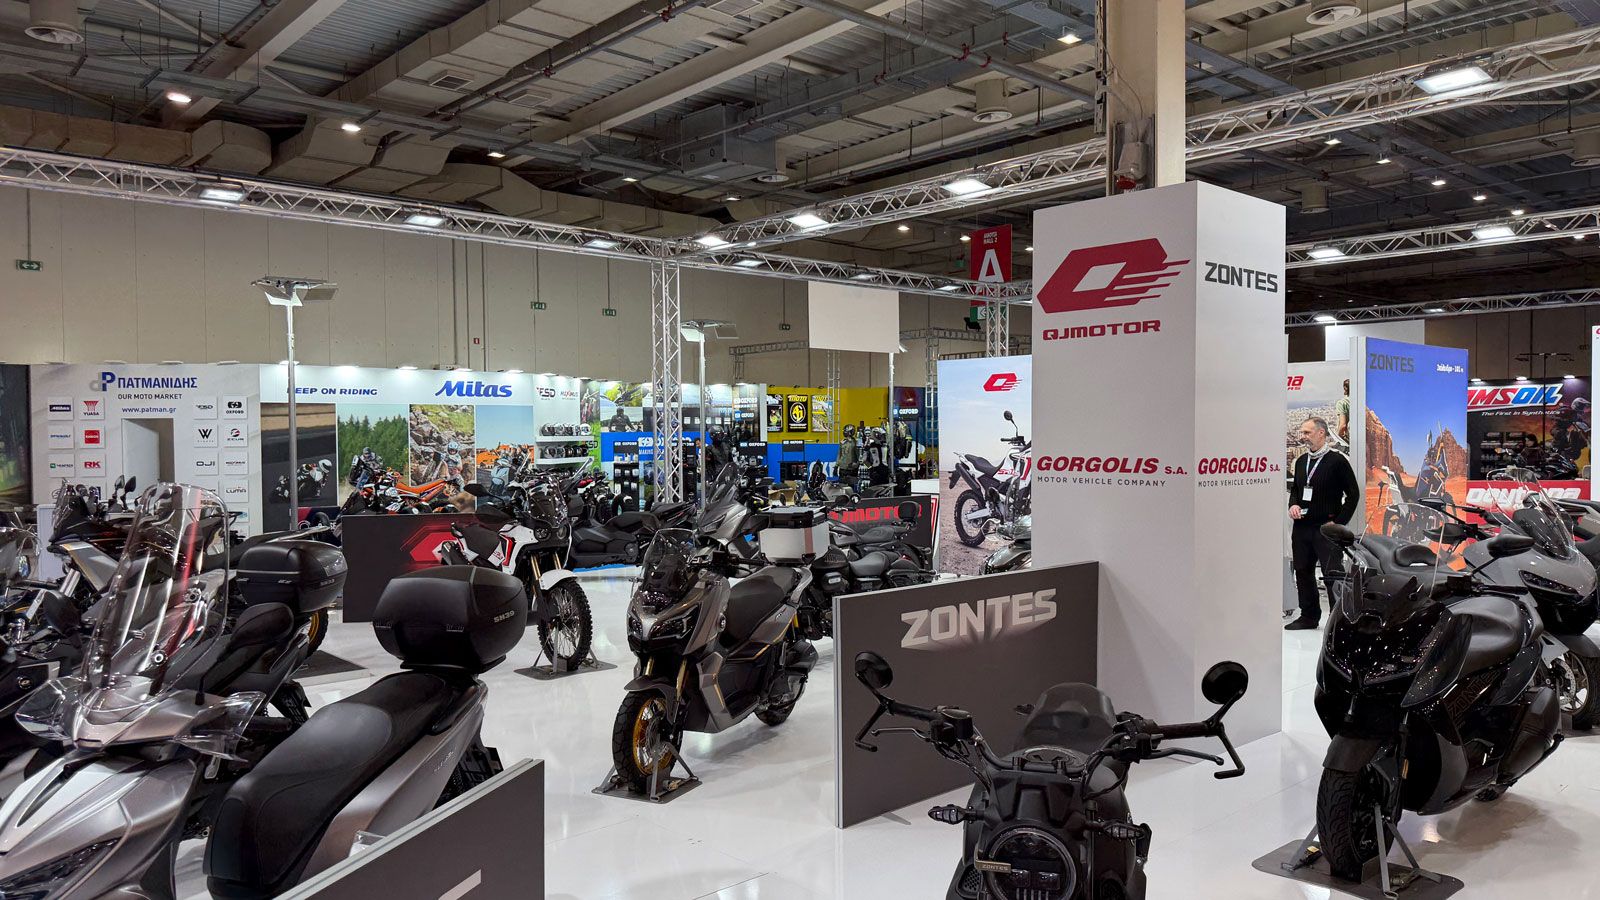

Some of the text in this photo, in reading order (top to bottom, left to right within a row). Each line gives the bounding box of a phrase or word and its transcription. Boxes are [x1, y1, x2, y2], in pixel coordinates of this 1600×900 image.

[1205, 261, 1278, 293] ZONTES
[1042, 320, 1161, 341] QJMOTOR
[1369, 353, 1415, 373] ZONTES
[117, 377, 198, 389] ΠΑΤΜΑΝΙΔΗΣ
[287, 387, 318, 395] EEP
[339, 388, 378, 396] RIDING
[434, 380, 513, 398] Mitas
[121, 406, 177, 415] www.patman.gr
[84, 461, 102, 469] RK
[1036, 456, 1160, 474] GORGOLIS
[1164, 465, 1188, 475] S.A.
[1198, 456, 1281, 475] GORGOLIS S.A.
[1037, 476, 1166, 488] MOTOR VEHICLE COMPANY
[1198, 478, 1271, 488] MOTOR VEHICLE COMPANY
[900, 588, 1057, 648] ZONTES
